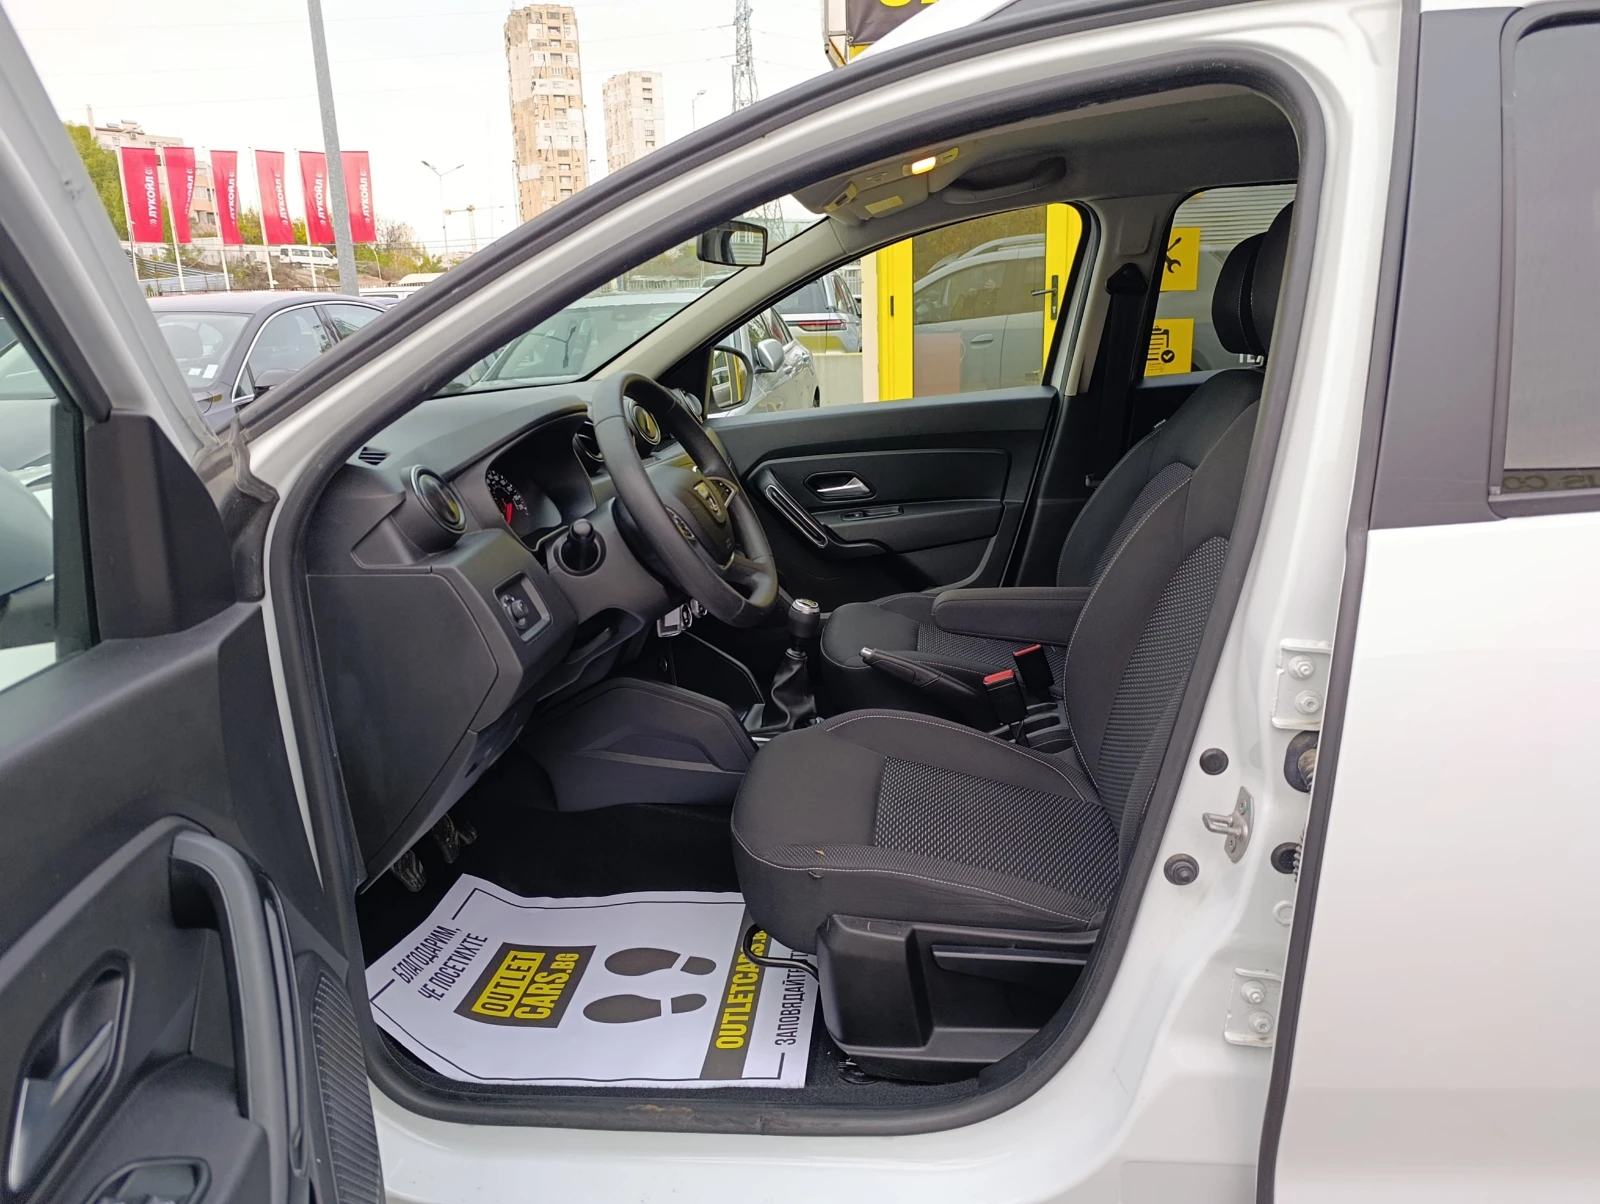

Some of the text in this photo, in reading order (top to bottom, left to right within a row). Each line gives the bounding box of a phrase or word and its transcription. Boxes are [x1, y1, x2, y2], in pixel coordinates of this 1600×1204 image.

[144, 175, 158, 219] ЛУКОЙЛ
[274, 178, 288, 220] ЛУКОЙЛ
[314, 178, 326, 220] ЛУКОЙЛ
[359, 177, 370, 217] ЛУКОЙЛ
[391, 925, 462, 984] БЛАГОДАРИМ,
[417, 933, 488, 1001] ЧЕ ПОСЕТИХТЕ
[480, 953, 539, 1016] OUTLET
[513, 952, 580, 1020] CARS.BG
